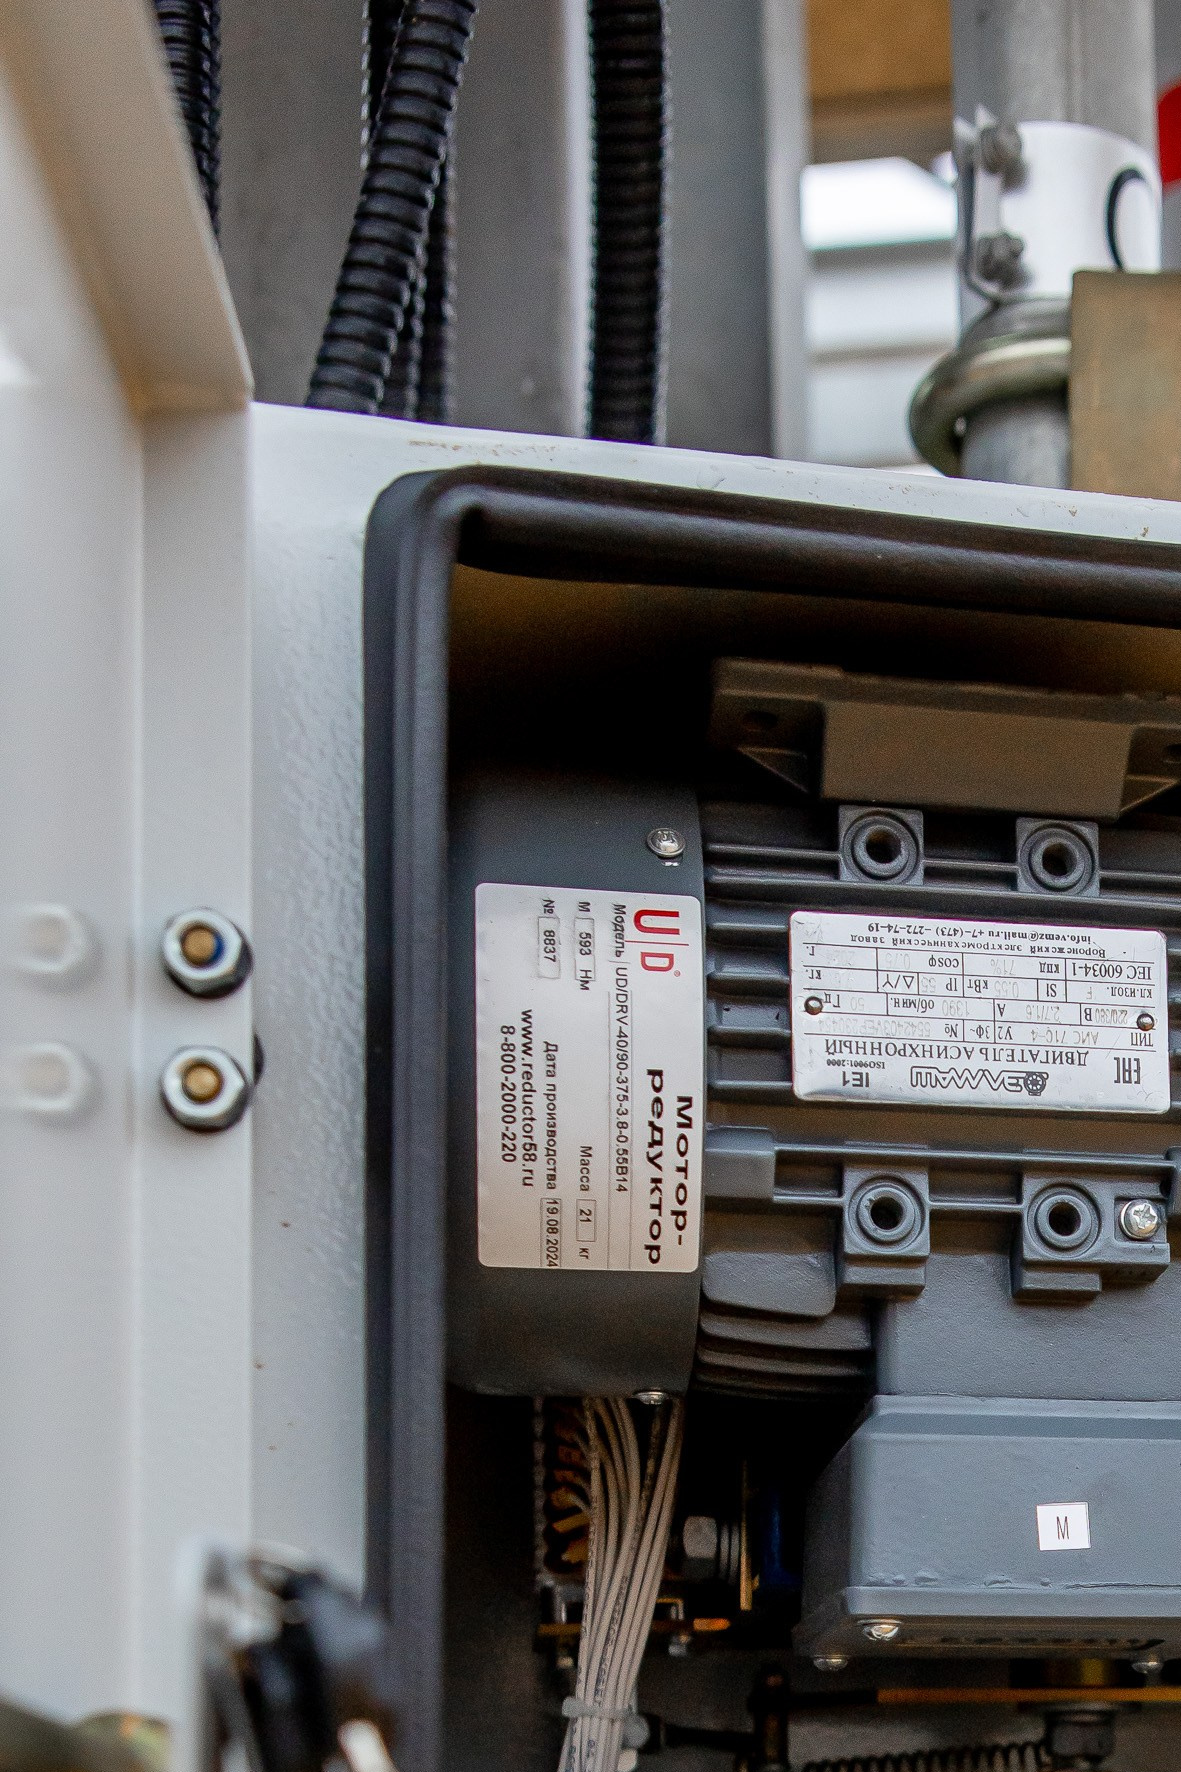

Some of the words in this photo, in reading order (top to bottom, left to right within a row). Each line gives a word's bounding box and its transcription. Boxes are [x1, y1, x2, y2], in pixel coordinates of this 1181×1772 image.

[543, 899, 555, 914] №
[612, 904, 627, 957] Модель
[988, 929, 1091, 944] info.vemz@mail.ru
[544, 930, 556, 963] 8837
[579, 931, 592, 956] 593
[850, 935, 884, 946] завод
[892, 937, 1023, 953] электромеханический
[1029, 944, 1106, 958] Воронежский
[805, 968, 822, 980] кг.
[1039, 962, 1059, 974] кпд
[1072, 962, 1123, 977] 60034-1
[1127, 965, 1152, 979] IEC
[579, 969, 592, 990] Нм
[945, 977, 958, 991] IP
[967, 979, 989, 993] кВт
[824, 993, 840, 1008] Гц
[890, 997, 934, 1011] об/мин.
[997, 1004, 1006, 1017] А
[1084, 1008, 1092, 1019] В
[944, 1023, 958, 1037] №
[997, 1026, 1012, 1040] У2
[1130, 1032, 1153, 1046] ТИП
[825, 1039, 974, 1060] АСИНХРОННЫЙ
[978, 1047, 1089, 1066] ДВИГАТЕЛЬ
[544, 1041, 558, 1078] Дата
[827, 1058, 886, 1069] ISO9001:2000
[841, 1071, 870, 1088] IE1
[500, 1025, 515, 1163] 8-800-2000-220
[521, 1009, 537, 1187] www.reductor58.ru
[545, 1083, 558, 1190] производства
[580, 1145, 593, 1191] Масса
[644, 1068, 667, 1265] редуктор
[670, 1095, 693, 1245] Мотор-
[580, 1208, 592, 1224] 21
[545, 1199, 559, 1267] 19.08.2024
[578, 1247, 590, 1259] кг
[1055, 1515, 1070, 1541] M
